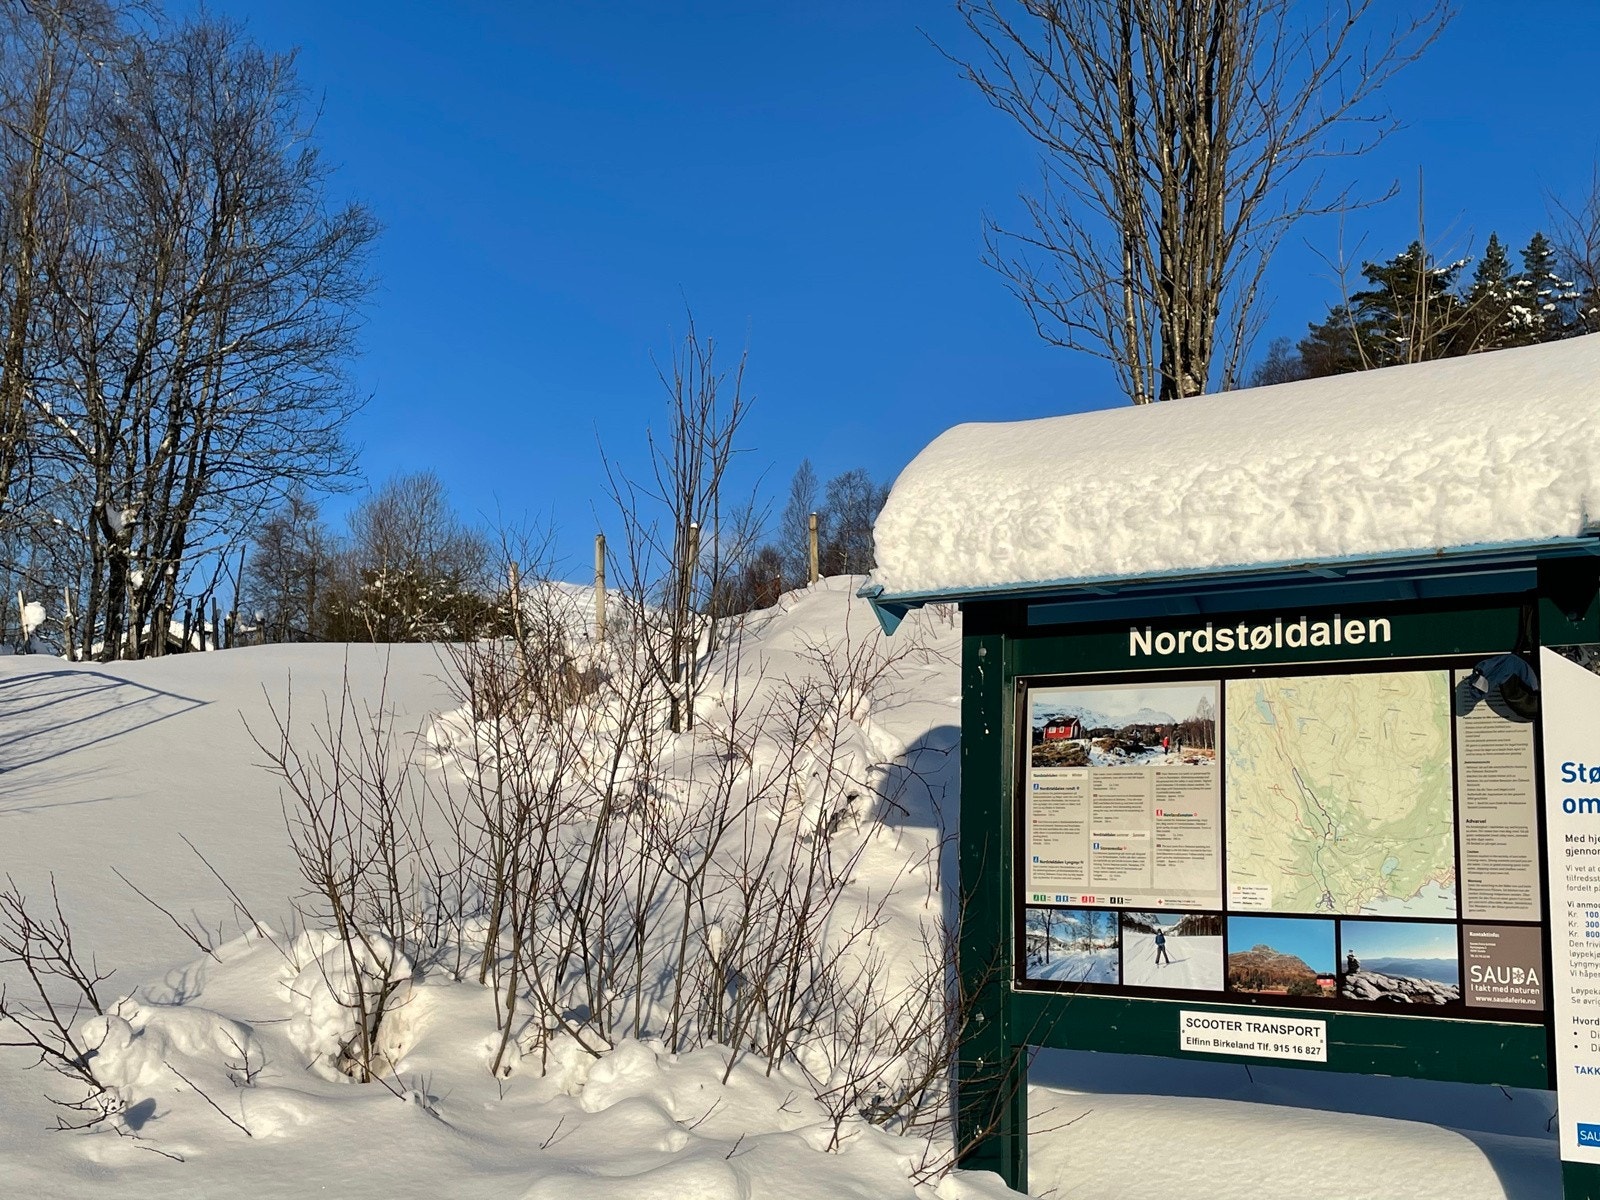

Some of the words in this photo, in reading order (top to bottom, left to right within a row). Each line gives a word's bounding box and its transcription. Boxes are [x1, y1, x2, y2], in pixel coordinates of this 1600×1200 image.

[1130, 614, 1391, 656] Nordstøldalen
[1561, 762, 1600, 784] Stø
[1562, 798, 1600, 814] om
[1565, 834, 1585, 842] Med
[1594, 885, 1600, 893] p
[1471, 965, 1539, 985] SAUDA
[1476, 996, 1536, 1004] www.saudaferie.no
[1186, 1018, 1243, 1032] SCOOTER
[1246, 1022, 1320, 1037] TRANSPORT
[1186, 1037, 1210, 1046] Elfinn
[1213, 1039, 1254, 1050] Birkeland
[1257, 1043, 1271, 1051] Tlf.
[1274, 1044, 1290, 1052] 915
[1292, 1045, 1302, 1053] 16
[1305, 1046, 1321, 1055] 827
